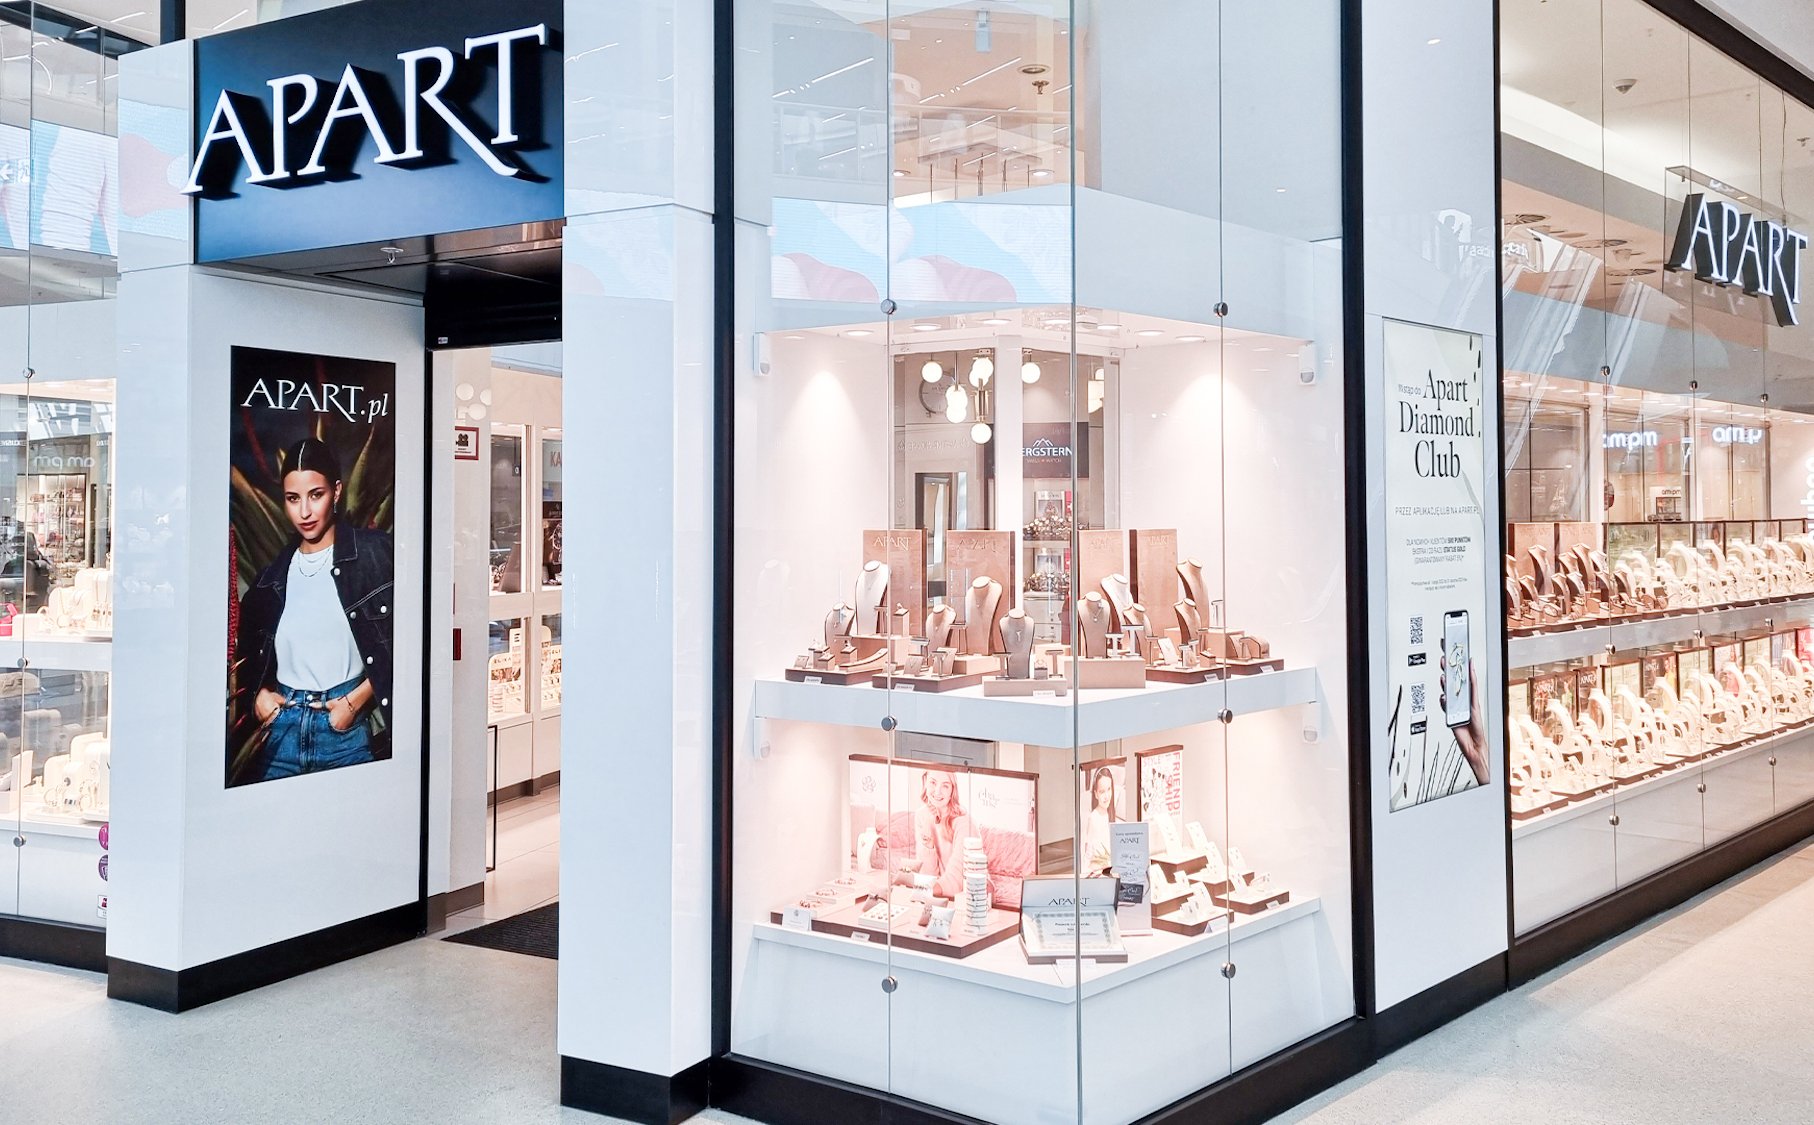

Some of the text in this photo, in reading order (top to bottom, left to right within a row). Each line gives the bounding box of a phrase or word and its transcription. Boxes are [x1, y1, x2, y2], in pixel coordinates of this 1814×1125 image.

[179, 23, 547, 195] APART
[1681, 193, 1809, 325] APART
[240, 377, 389, 424] APART.pl
[1423, 369, 1468, 410] Apart
[1398, 401, 1474, 437] Diamond
[1415, 440, 1461, 478] Club
[1395, 506, 1412, 516] PRZEZ
[874, 536, 911, 551] APART
